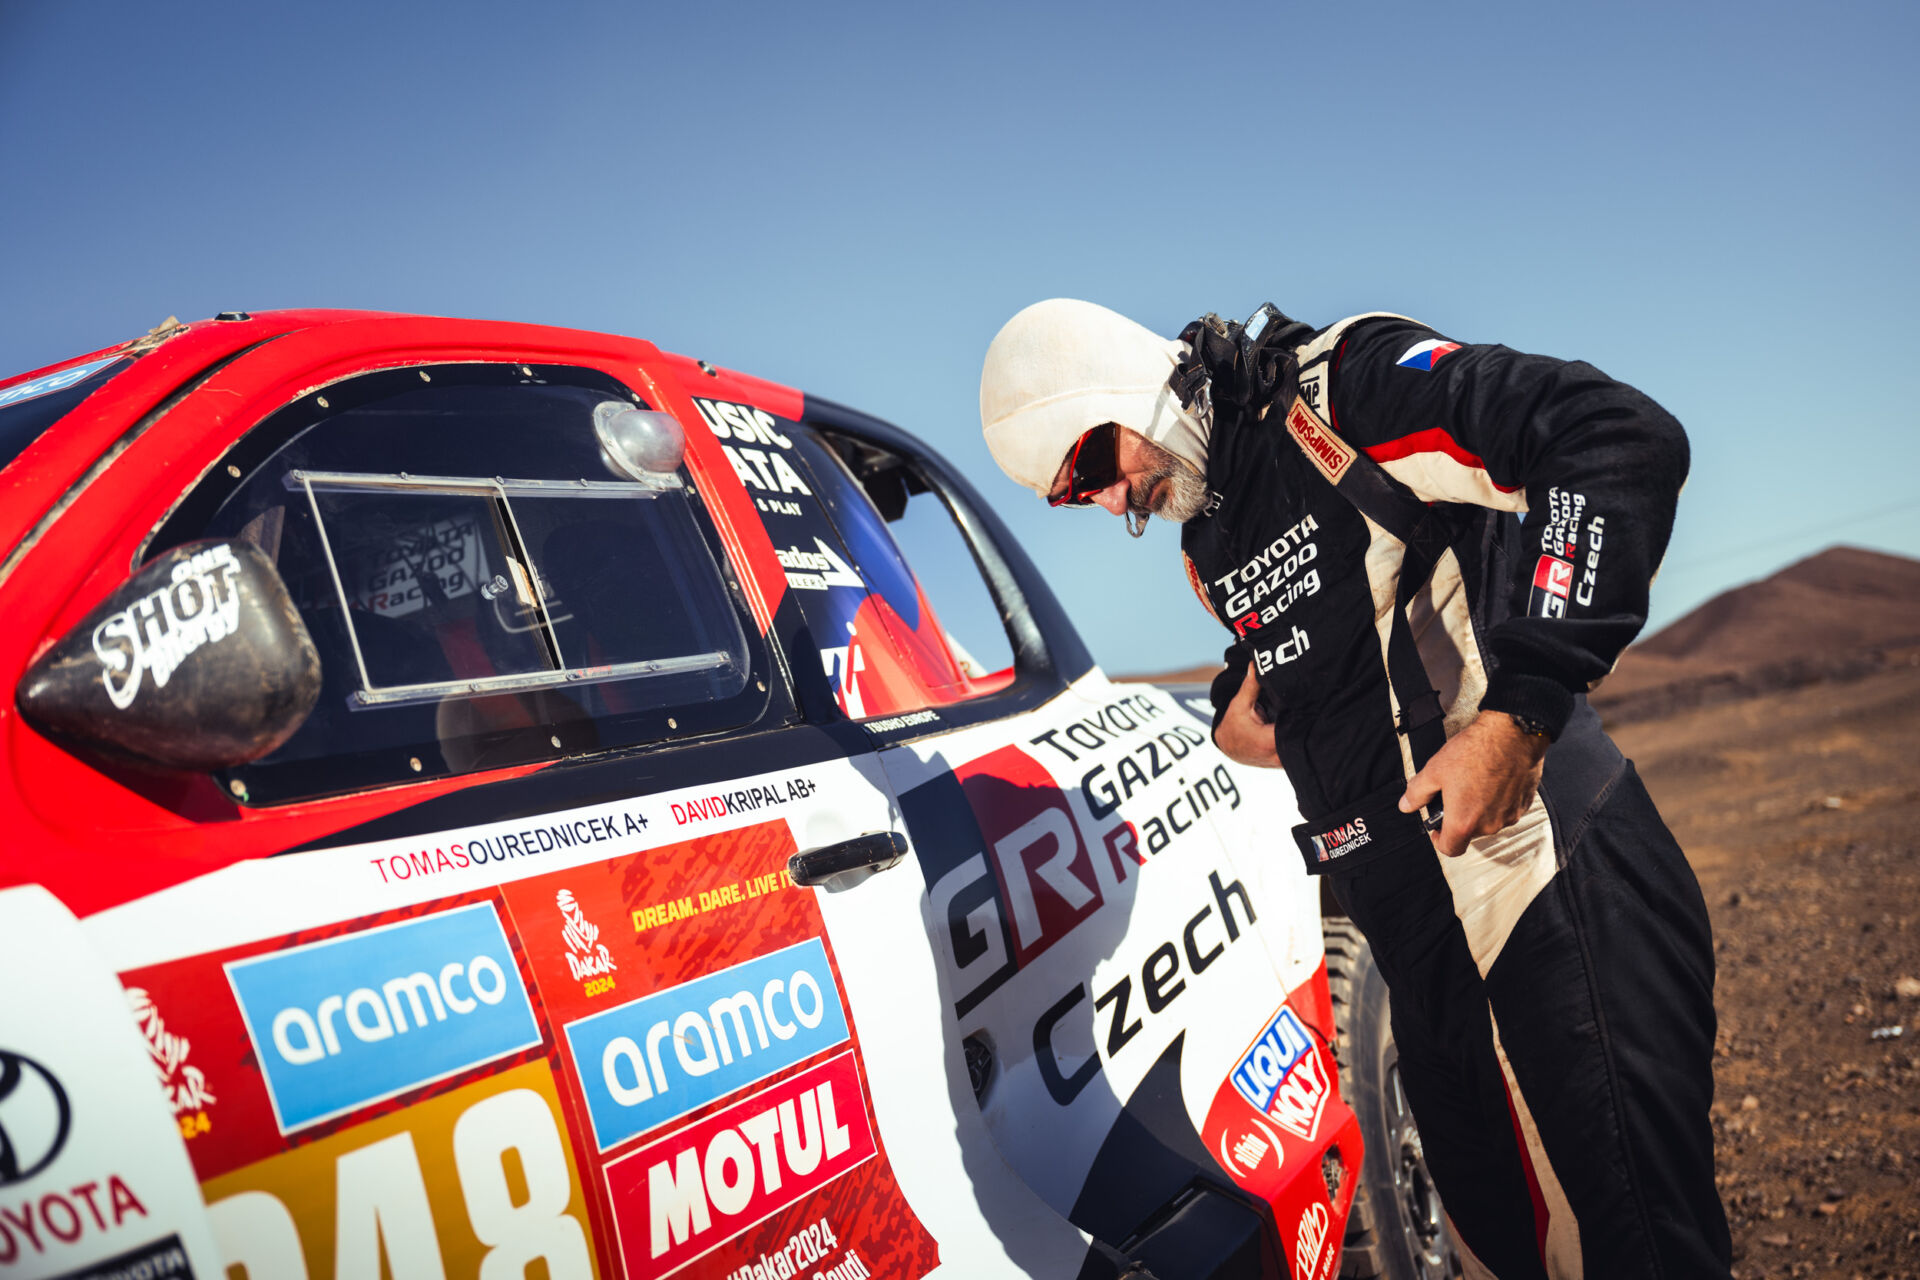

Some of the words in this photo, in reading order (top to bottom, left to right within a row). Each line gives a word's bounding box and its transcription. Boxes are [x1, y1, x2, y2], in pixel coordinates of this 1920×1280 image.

[1292, 410, 1343, 470] SIMPSON
[771, 499, 802, 516] PLAY
[1541, 486, 1559, 551] TOYOTA
[1552, 491, 1571, 557] GAZOO
[1565, 493, 1587, 560] Racing
[1214, 513, 1320, 597] TOYOTA
[1223, 542, 1319, 620] GAZOO
[1575, 516, 1606, 608] Czech
[1232, 567, 1322, 639] Racing
[1540, 560, 1571, 619] GR
[1253, 624, 1311, 676] ech
[1030, 694, 1166, 762] TOYOTA
[787, 778, 817, 801] AB+
[1080, 725, 1206, 821] GAZOO
[625, 812, 649, 836] A+
[1103, 763, 1241, 885] Racing
[1322, 817, 1367, 849] TOMAS
[1329, 833, 1372, 859] OUREDNICEK
[632, 896, 699, 932] DREAM.
[698, 882, 746, 912] DARE.
[747, 872, 778, 899] LIVE
[928, 806, 1097, 976] GR
[565, 944, 617, 981] DAKAR
[584, 975, 616, 998] 2024
[1032, 869, 1258, 1107] Czech
[272, 955, 507, 1065] aramco
[602, 970, 824, 1107] aramco
[1234, 1014, 1308, 1110] LIQUI
[1270, 1050, 1324, 1136] MOLY
[648, 1080, 851, 1260] MOTUL
[726, 1217, 838, 1280] Dakar2024
